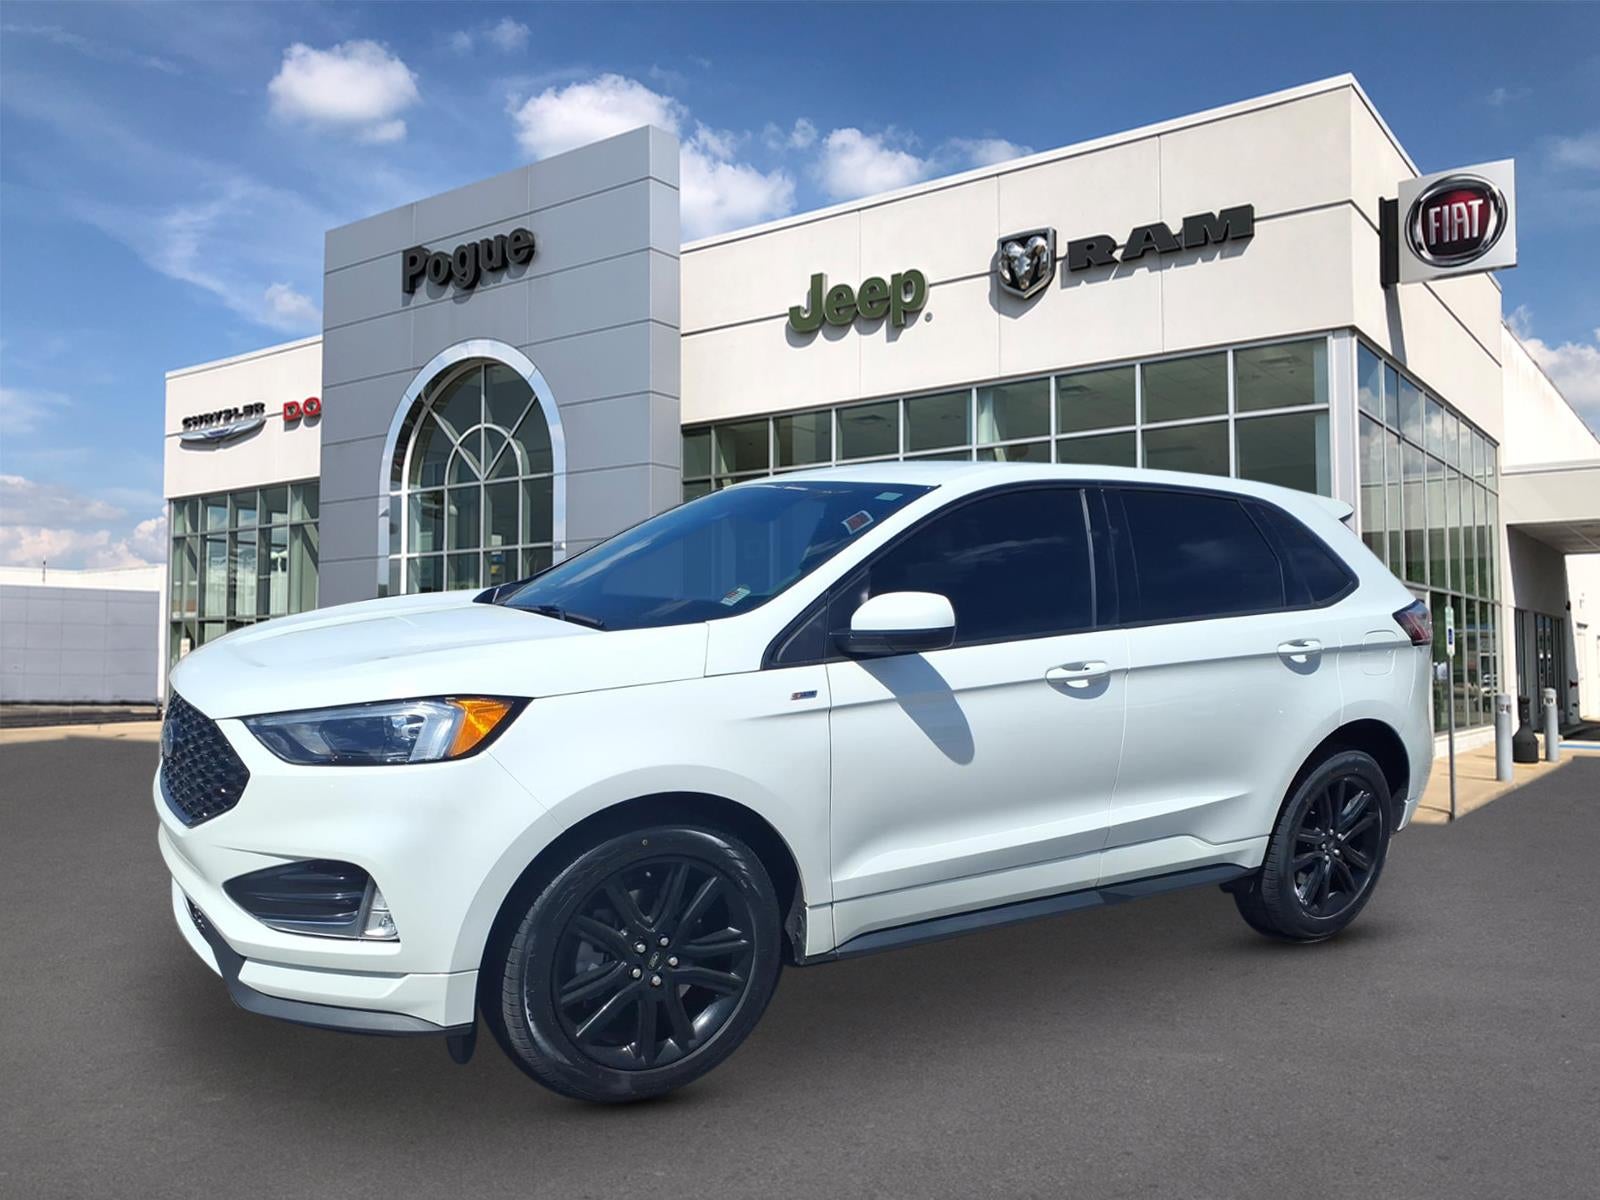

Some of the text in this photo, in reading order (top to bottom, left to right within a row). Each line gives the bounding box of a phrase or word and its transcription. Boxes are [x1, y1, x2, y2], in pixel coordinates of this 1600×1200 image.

[1067, 203, 1254, 271] RAM
[1429, 199, 1483, 246] FIAT
[402, 228, 535, 294] Pogue
[789, 269, 928, 333] Jeep
[182, 402, 265, 428] CHRYSLER
